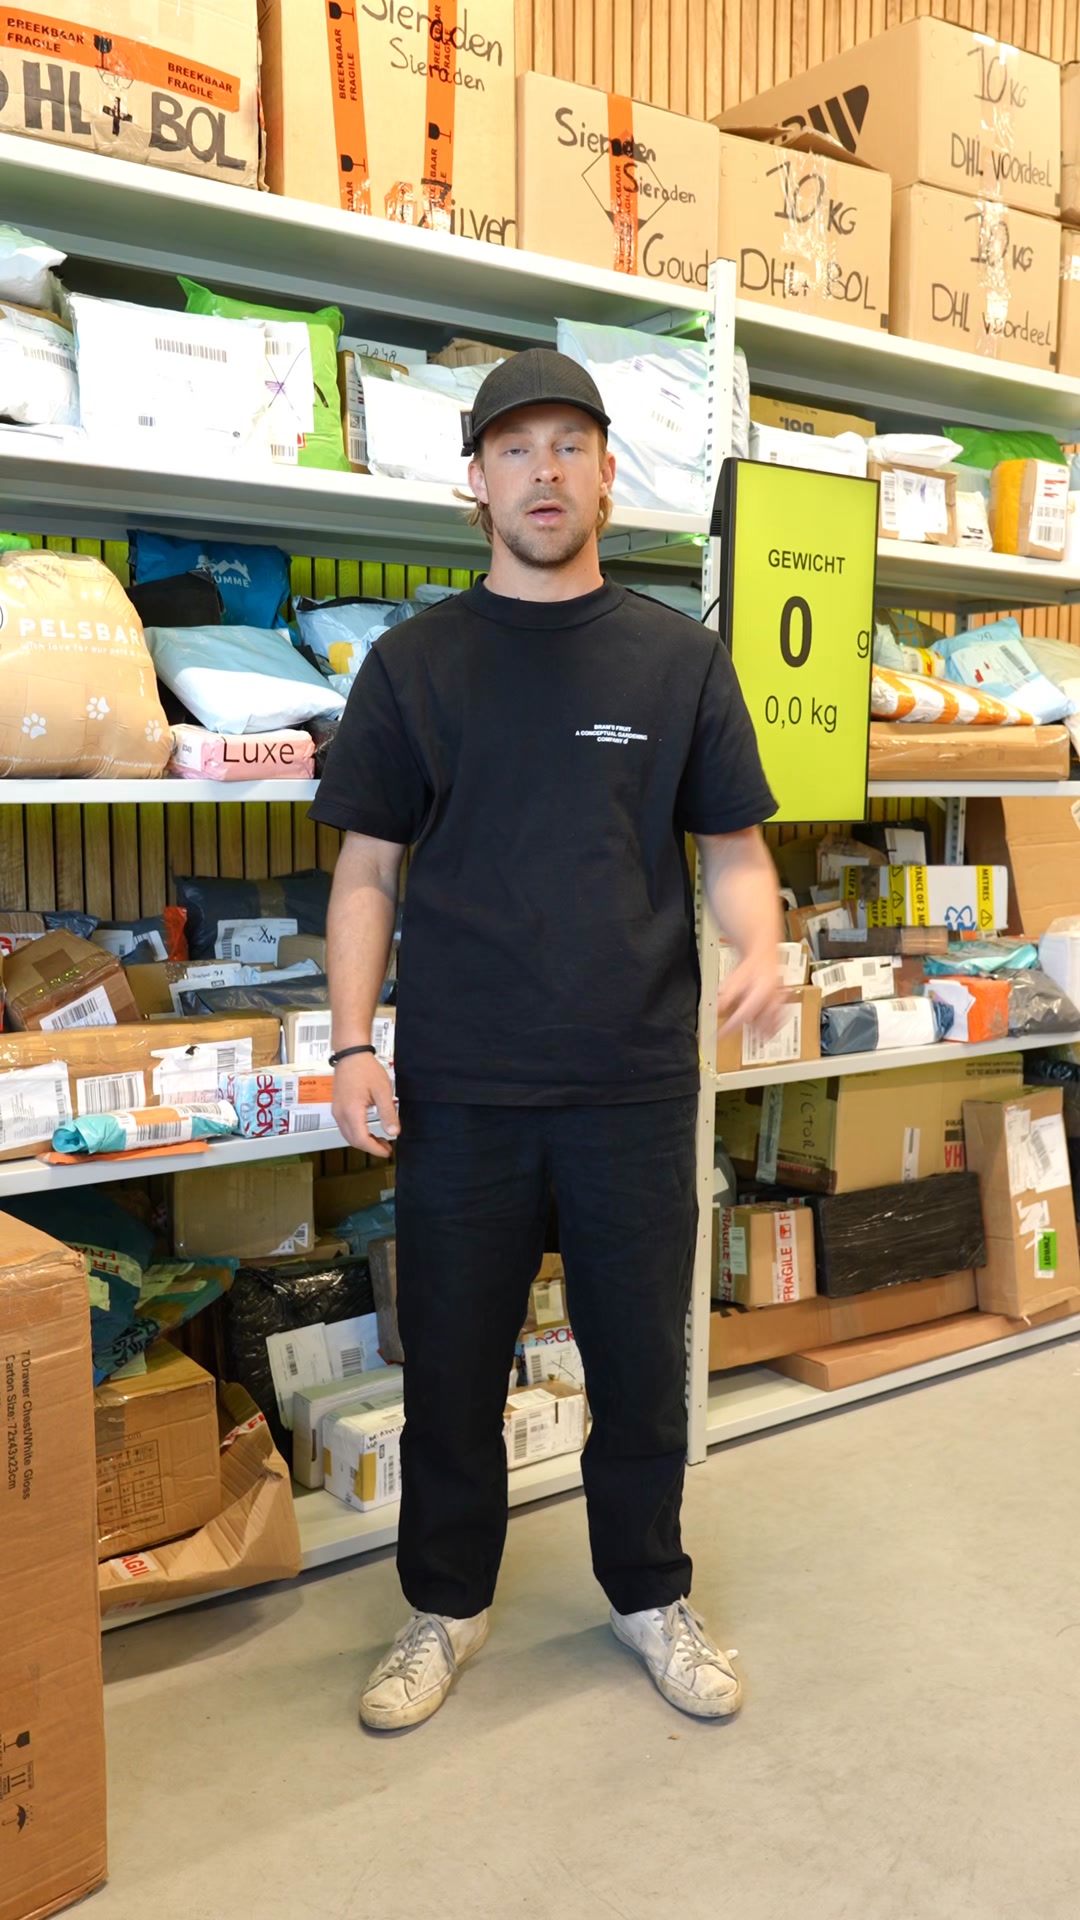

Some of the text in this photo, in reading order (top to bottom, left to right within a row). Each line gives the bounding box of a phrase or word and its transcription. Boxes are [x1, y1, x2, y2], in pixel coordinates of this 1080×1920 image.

[7, 17, 85, 45] BREEKBAAR
[7, 32, 61, 53] FRAGILE
[167, 62, 233, 93] BREEKBAAR
[334, 29, 346, 99] BREEKBAAR
[348, 52, 358, 101] FRAGILE
[389, 37, 485, 91] Sieraden
[967, 46, 1008, 103] 10
[167, 76, 214, 99] FRAGILE
[0, 59, 92, 135] HL
[149, 91, 247, 171] BOL
[951, 132, 984, 177] DHL
[623, 162, 697, 203] Sieraden
[766, 161, 825, 223] 10
[643, 233, 709, 286] Goud
[932, 283, 970, 332] DHL
[768, 549, 845, 574] GEWICHT
[213, 575, 250, 588] UMME
[19, 618, 146, 647] PELSBAR
[780, 596, 870, 667] 0 g
[765, 696, 838, 733] 0,0 kg
[222, 740, 295, 765] Luxe
[982, 868, 990, 901] METRES
[781, 1247, 795, 1302] FRAGILE
[5, 1354, 16, 1392] Carton
[21, 1360, 31, 1399] Drawer
[22, 1468, 33, 1500] Gloss
